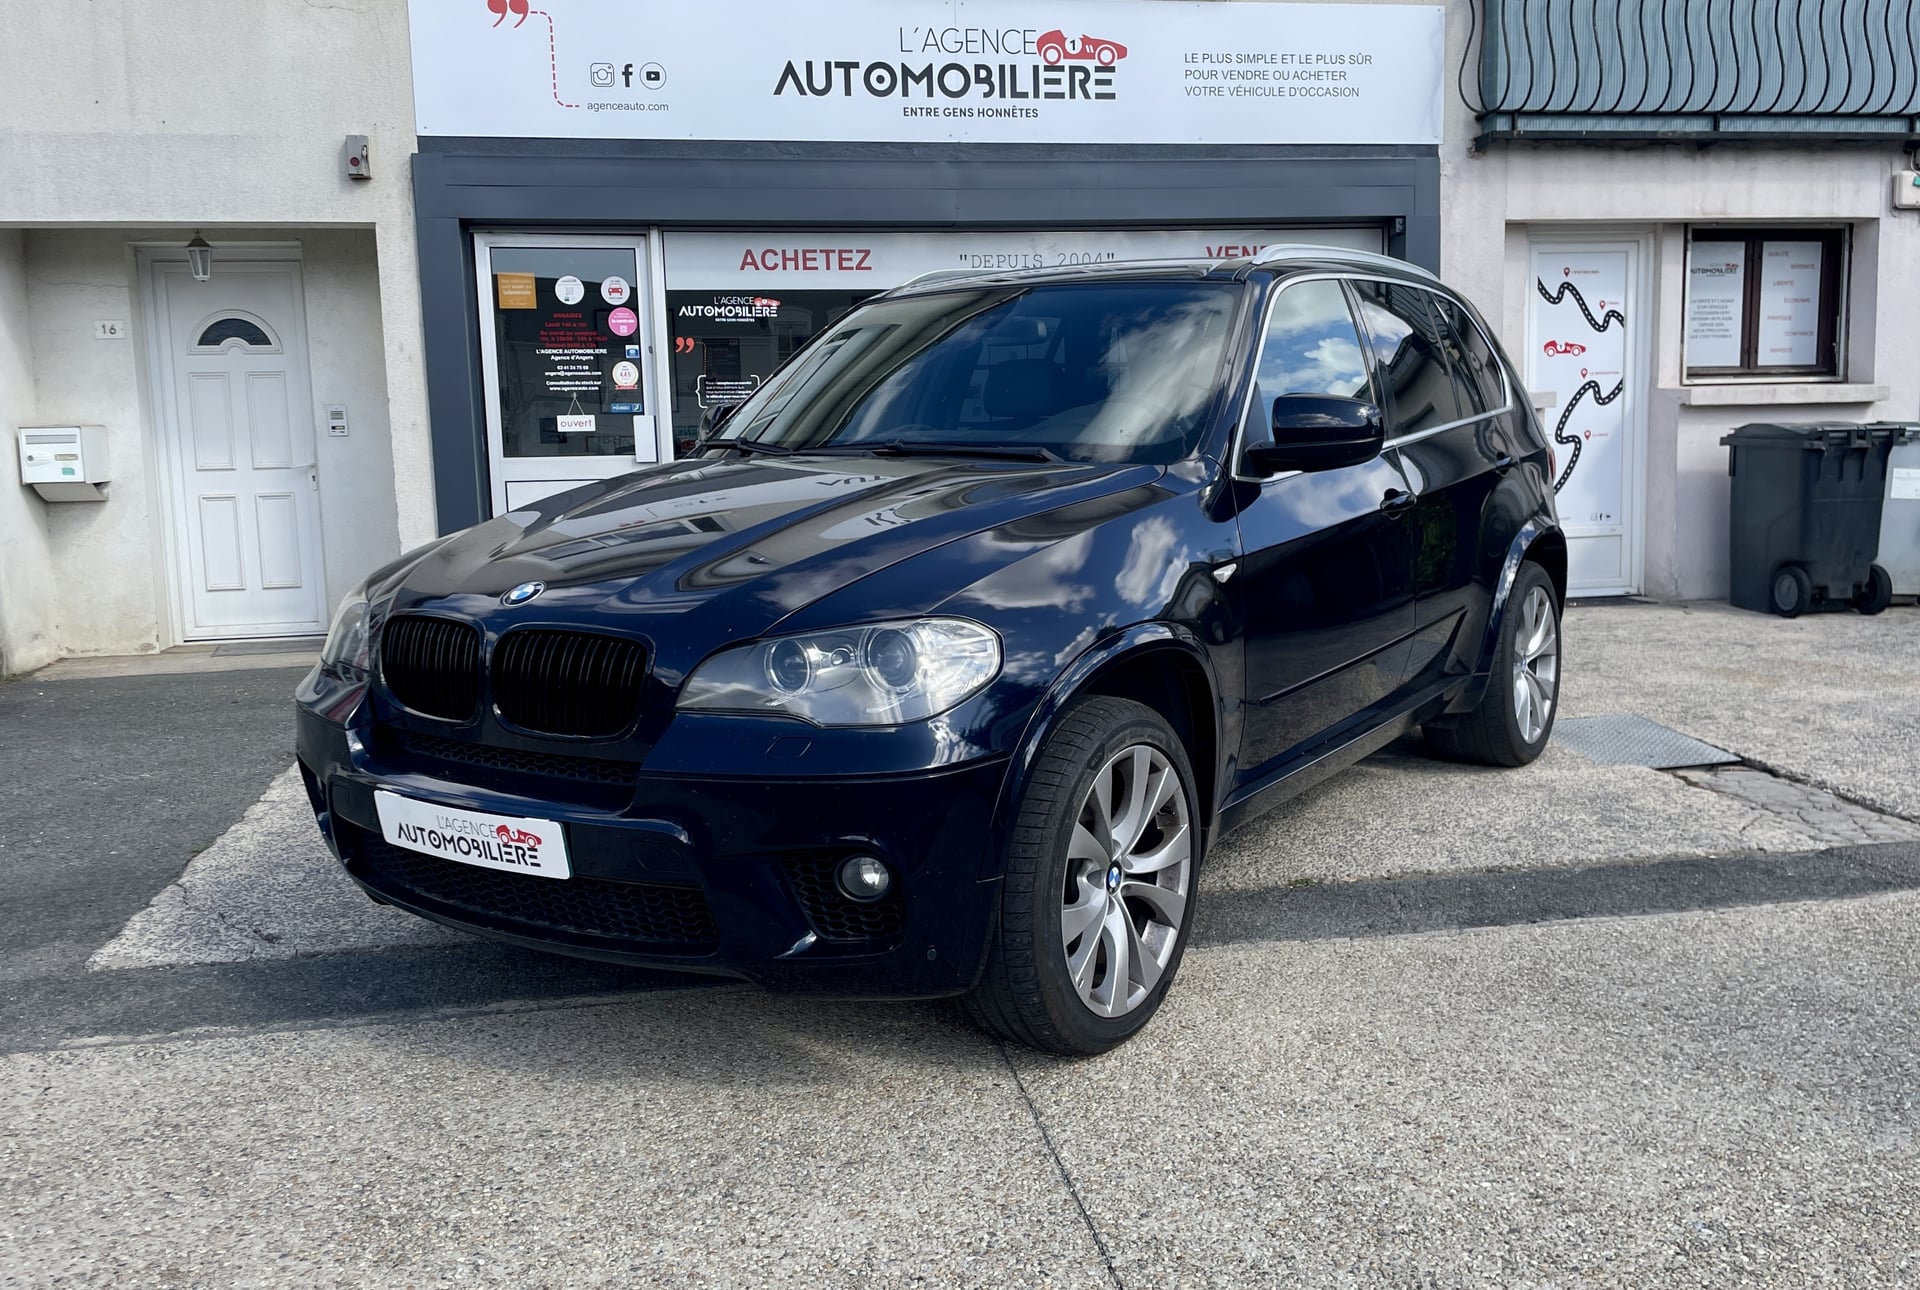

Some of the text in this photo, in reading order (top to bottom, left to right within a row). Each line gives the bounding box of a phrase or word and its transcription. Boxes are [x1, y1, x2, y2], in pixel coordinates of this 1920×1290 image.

[899, 27, 1038, 55] L'AGENCE
[1184, 52, 1373, 65] LE PLUS SIMPLE ET LE PLUS SÛR
[1184, 69, 1348, 82] POUR VENDRE OU ACHETER
[1184, 84, 1361, 98] VOTRE VÉHICULE D'OCCASION
[587, 102, 669, 113] agenceauto.com
[903, 105, 1039, 119] ENTRE GENS HONNÊTES
[739, 248, 873, 271] ACHETEZ
[713, 296, 755, 305] L'AGENCE
[101, 323, 117, 335] 16
[560, 419, 592, 428] ouvert
[436, 814, 498, 839] L'AGENCE
